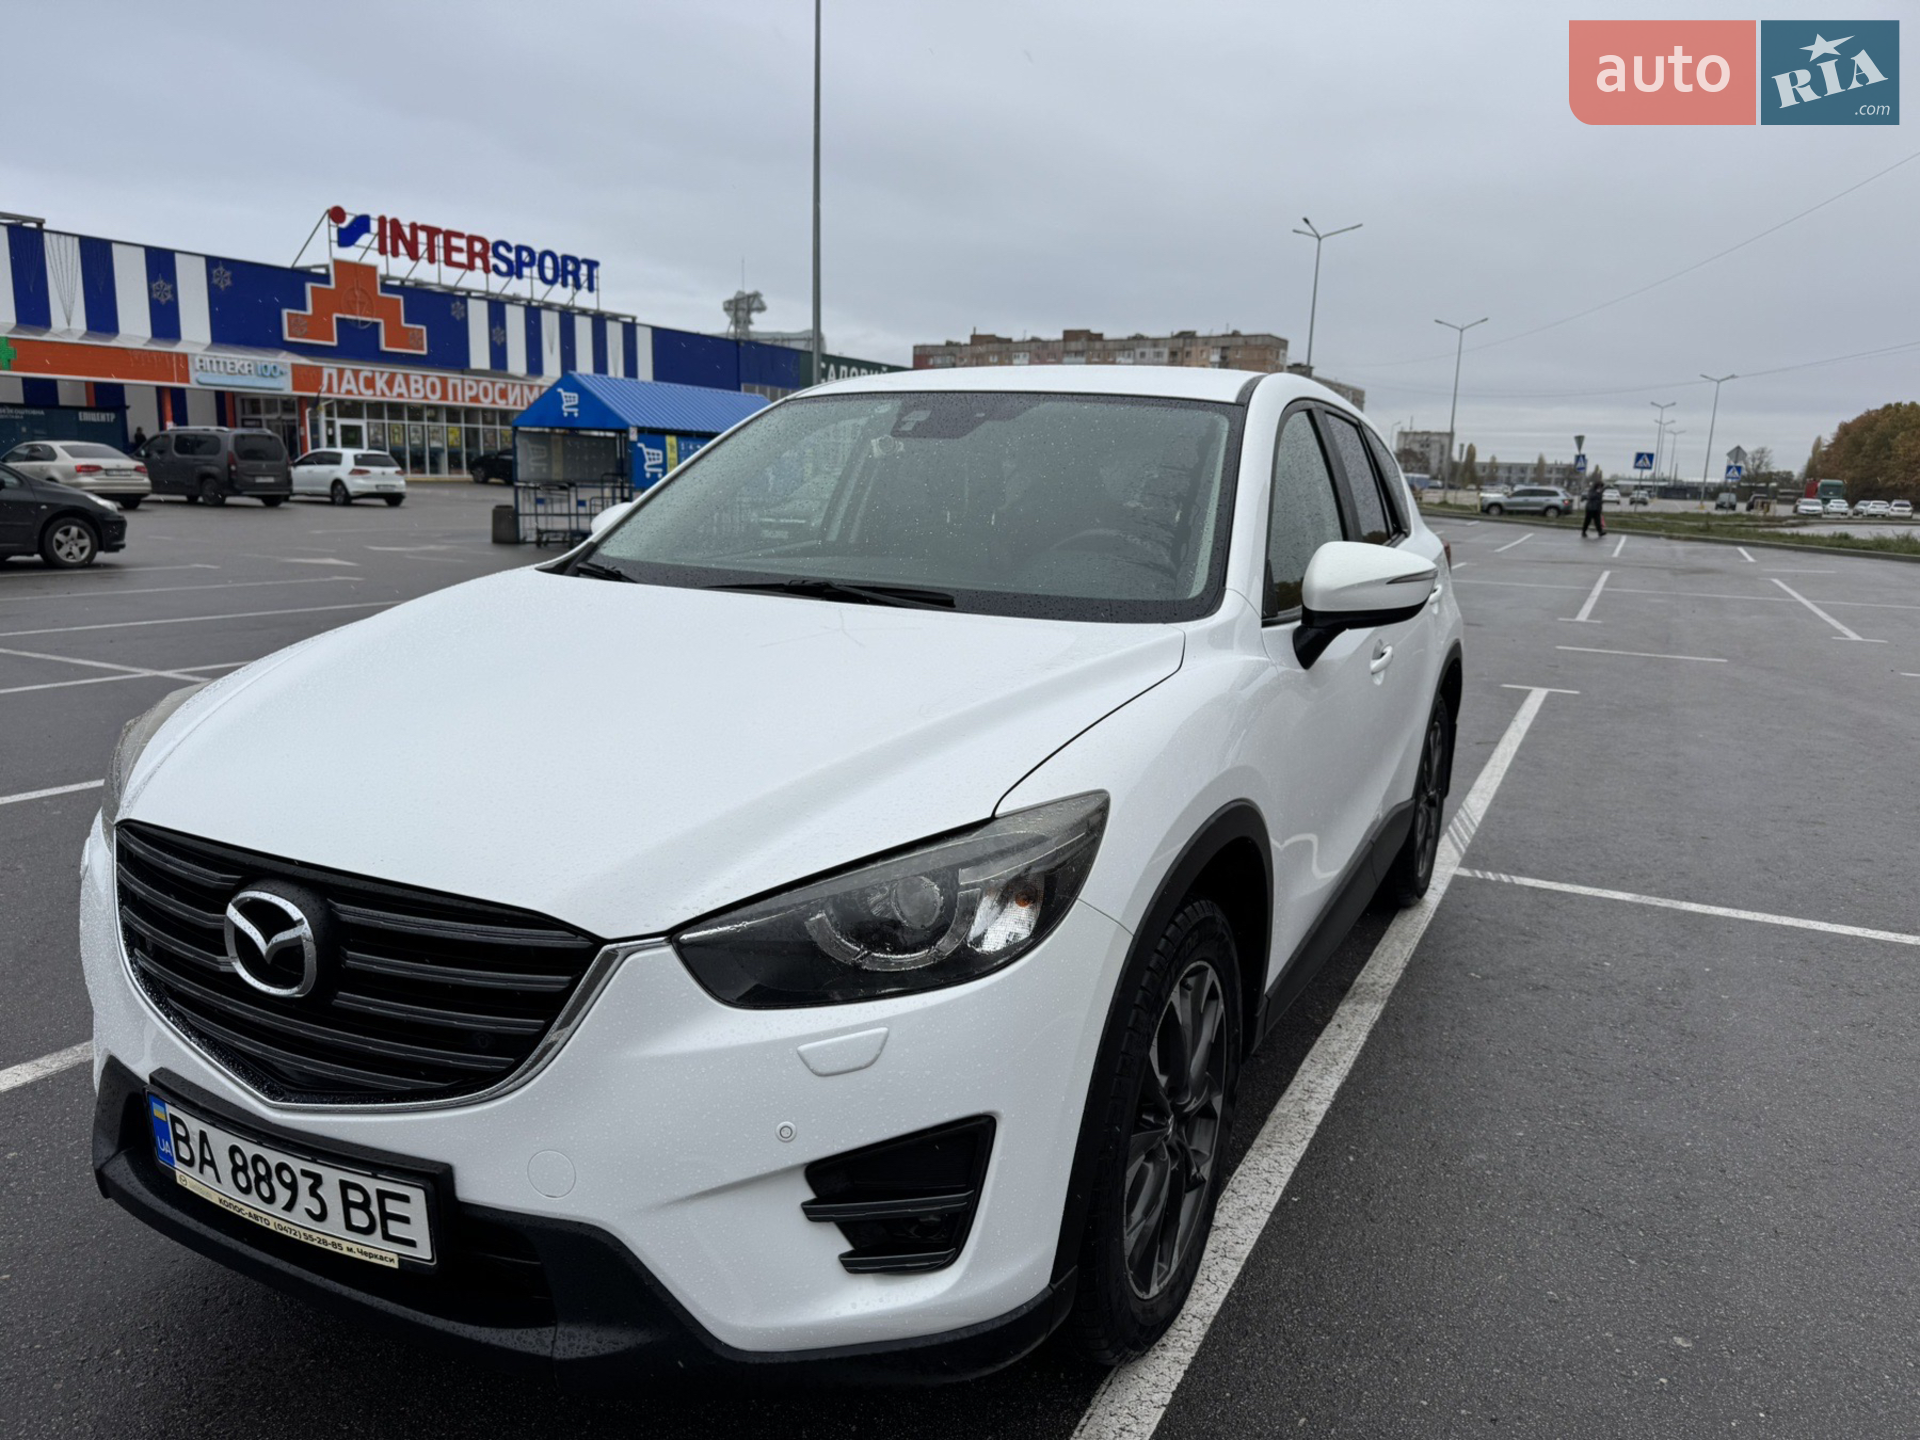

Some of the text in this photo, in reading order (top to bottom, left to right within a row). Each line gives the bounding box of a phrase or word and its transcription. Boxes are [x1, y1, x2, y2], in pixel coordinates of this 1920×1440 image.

[378, 214, 600, 293] INTERSPORT
[195, 357, 254, 376] АПТЕКА
[321, 367, 442, 400] ЛАСКАВО
[157, 1136, 172, 1157] UA
[169, 1112, 417, 1248] BA 8893 BE
[273, 1221, 302, 1239] (0472)
[303, 1232, 343, 1251] 55-28-85
[357, 1247, 396, 1264] Черкаси
